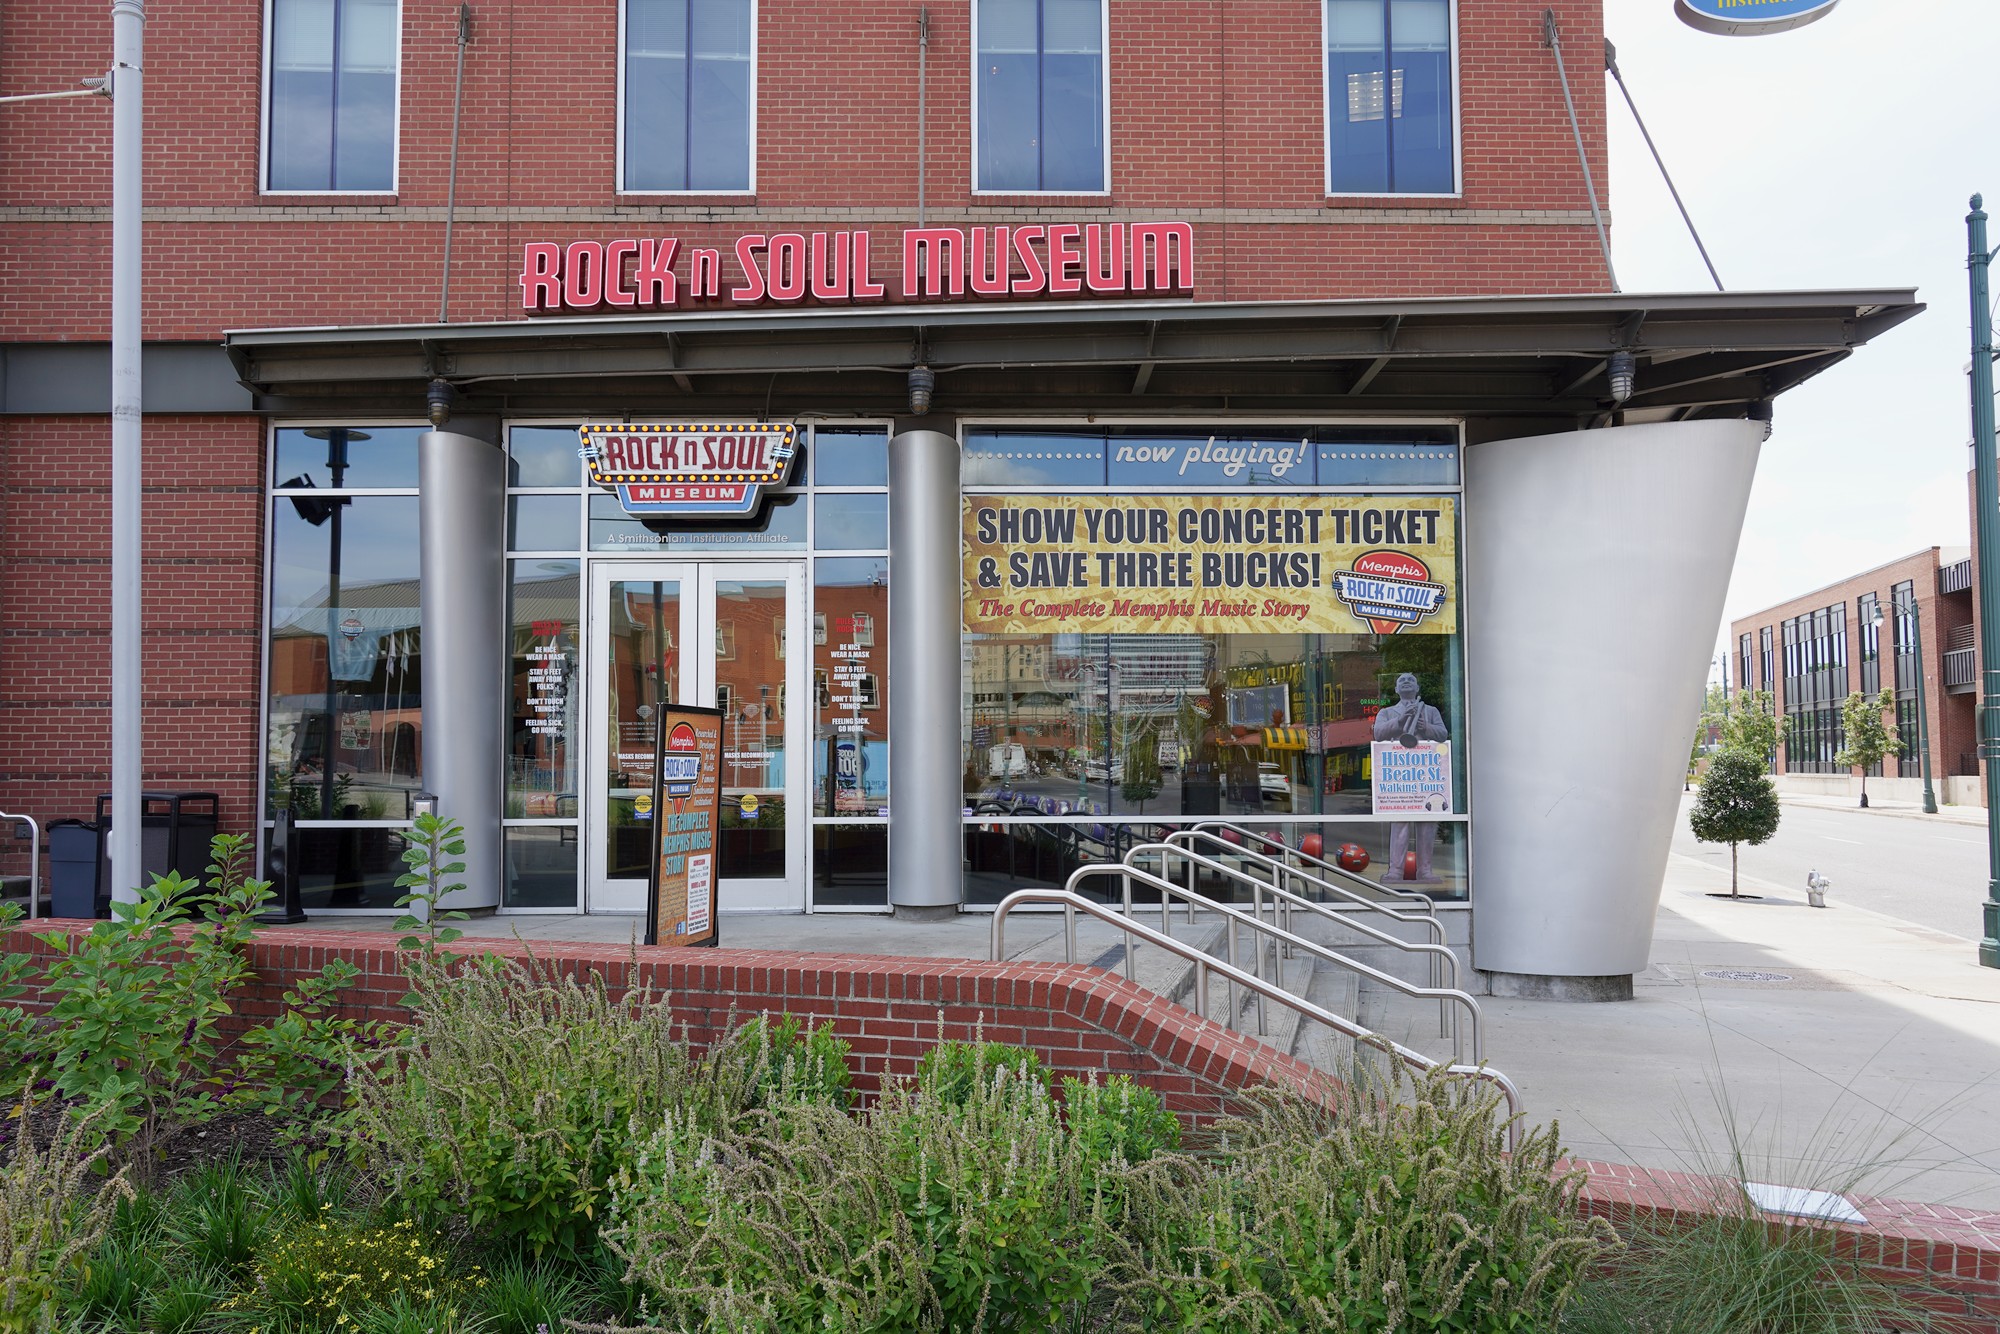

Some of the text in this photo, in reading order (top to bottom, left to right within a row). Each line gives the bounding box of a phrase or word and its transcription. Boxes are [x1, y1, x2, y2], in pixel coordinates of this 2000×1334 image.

[519, 221, 1194, 309] ROCK n SOUL MUSEUM
[606, 435, 769, 471] ROCK n SOUL
[1115, 436, 1309, 478] now playing!
[977, 507, 1441, 545] SHOW YOUR CONCERT TICKET
[607, 533, 789, 544] A Smithsonian Institution Affiliate
[978, 552, 1321, 588] & SAVE THREE BUCKS!
[1361, 560, 1423, 578] Memphis
[1346, 578, 1431, 607] ROCK n SOUL
[979, 599, 1311, 621] The Complete Memphis Music Story
[841, 680, 859, 688] FOLKS
[534, 705, 555, 713] THINGS
[831, 695, 868, 703] DON'T TOUCH
[525, 719, 547, 727] FEELING
[670, 735, 695, 751] Memphis
[666, 758, 680, 778] ROCK
[683, 758, 697, 778] SOUL
[1382, 751, 1441, 767] Historic
[1382, 766, 1446, 781] Beale St.
[1379, 782, 1445, 794] Walking Tours
[667, 811, 709, 832] THE COMPLETE
[663, 831, 711, 854] MEMPHIS MUSIC
[666, 854, 685, 876] STORY
